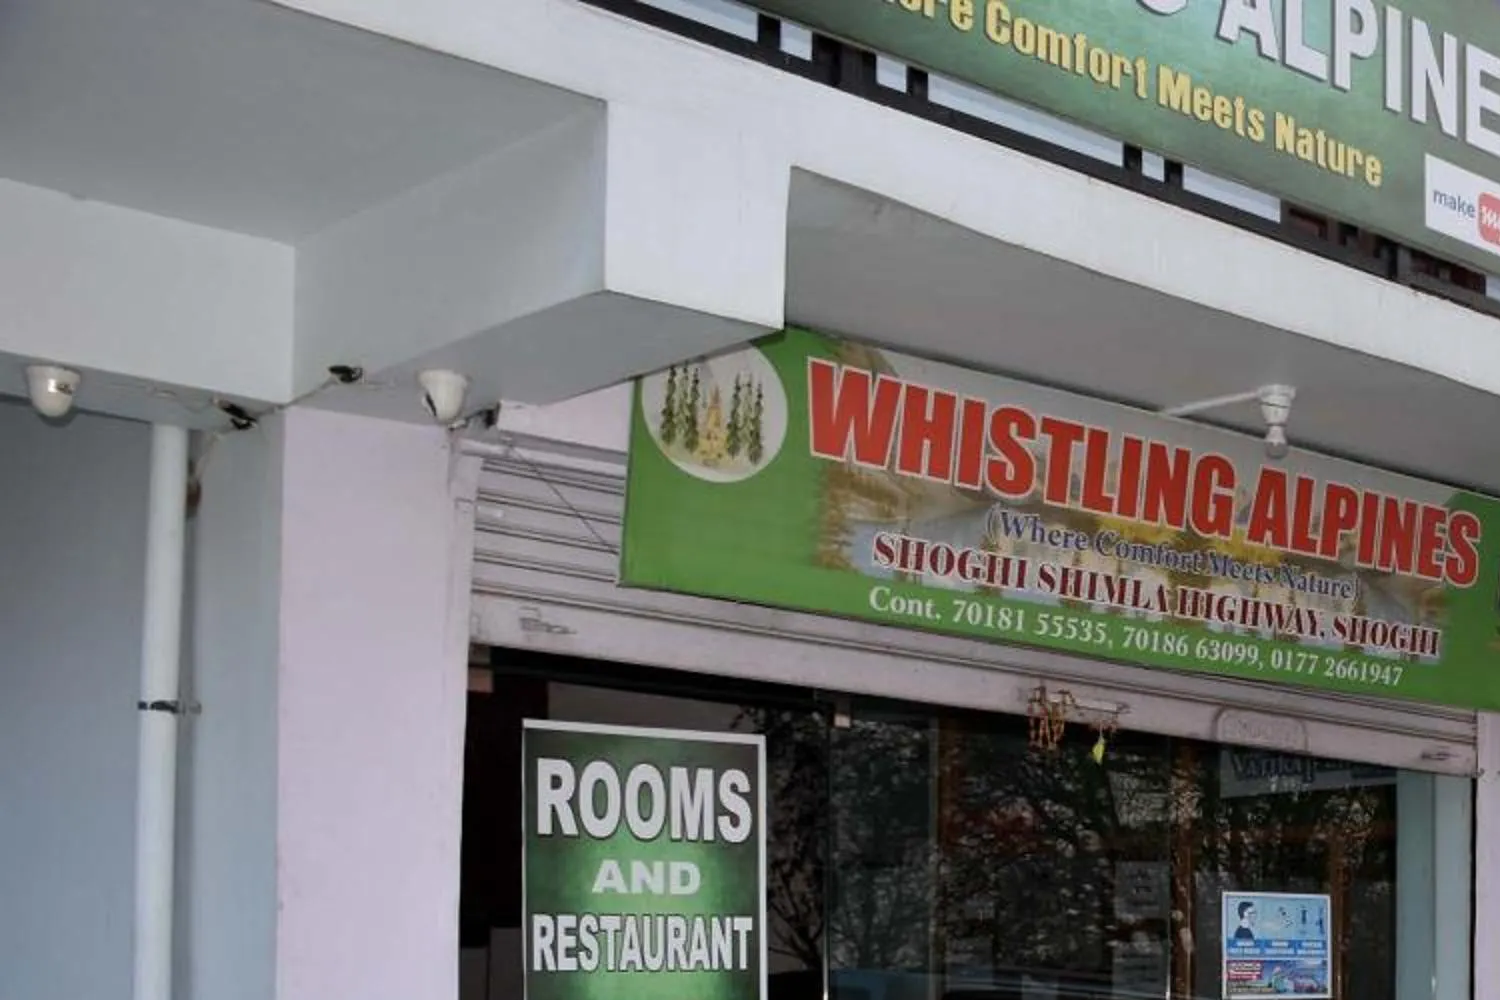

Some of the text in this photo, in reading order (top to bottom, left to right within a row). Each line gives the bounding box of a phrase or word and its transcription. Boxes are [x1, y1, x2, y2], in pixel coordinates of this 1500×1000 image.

[985, 0, 1383, 188] Comfort Meets Nature
[1433, 190, 1476, 219] make
[808, 357, 1481, 588] WHISTLING ALPINES
[872, 531, 1028, 590] SHOGHI
[1037, 561, 1168, 613] SHIMLA
[1333, 614, 1442, 658] SHOGHI
[1097, 531, 1202, 573] Comfort
[1204, 550, 1274, 585] Meets
[869, 586, 1403, 687] Cont. 70181 55535, 70186 63099, 0177 2661947
[536, 757, 753, 844] ROOMS
[592, 858, 701, 895] AND
[532, 914, 753, 971] RESTAURANT
